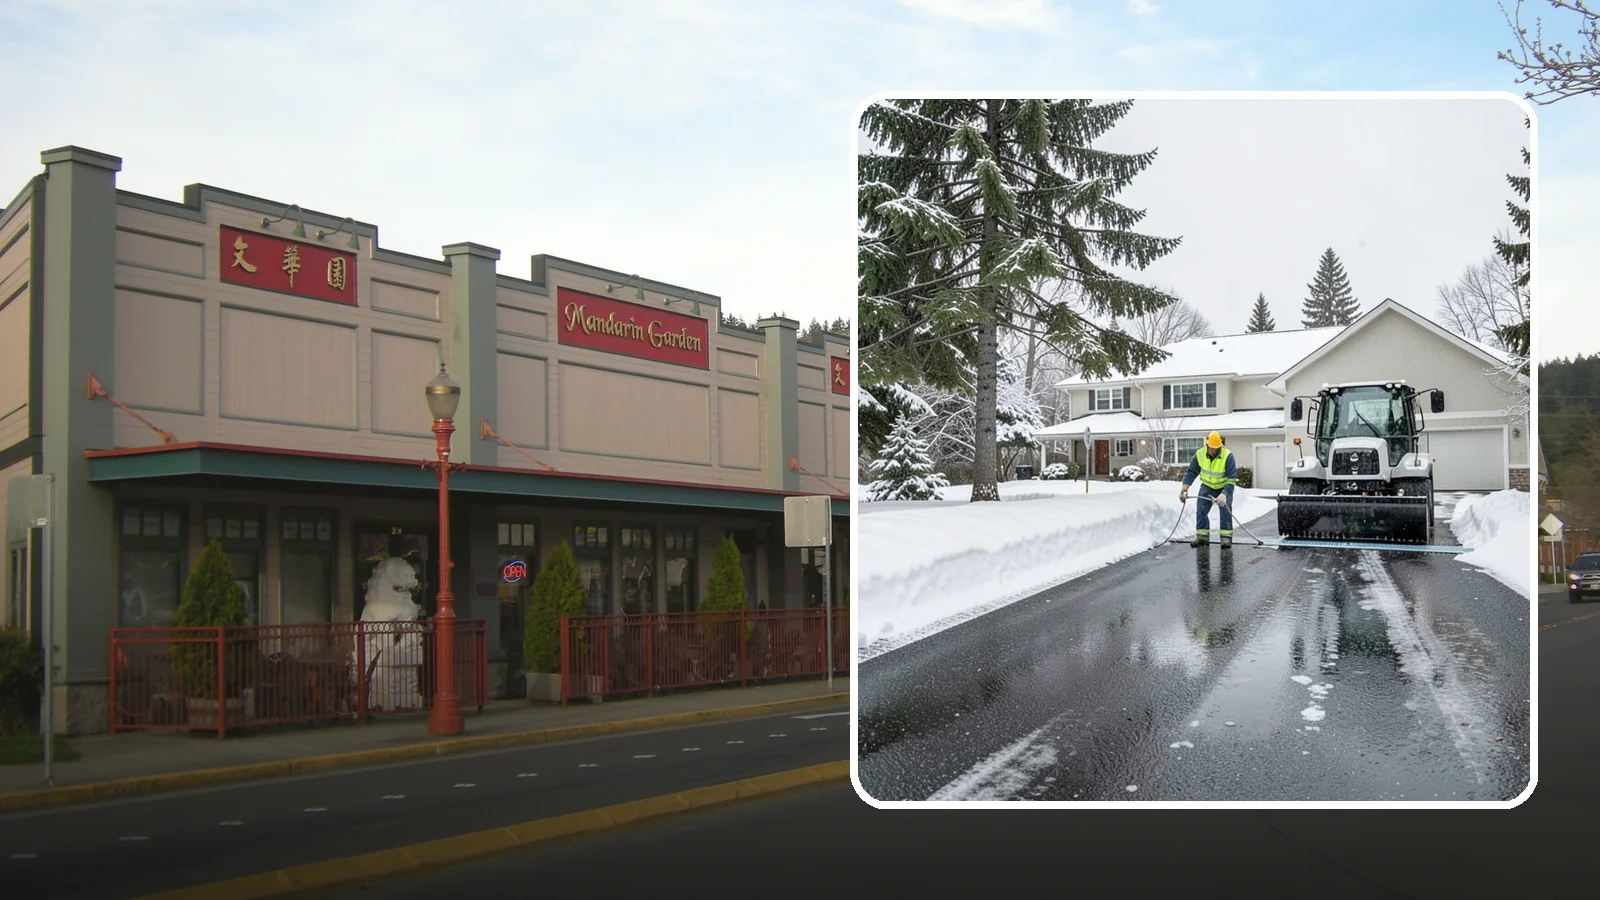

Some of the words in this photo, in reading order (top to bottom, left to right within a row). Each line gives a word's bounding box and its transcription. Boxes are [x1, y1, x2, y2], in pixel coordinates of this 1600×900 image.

[230, 235, 346, 291] 文華園
[564, 302, 644, 342] Mandarin
[647, 320, 701, 352] Garden
[834, 363, 846, 386] 文
[503, 565, 527, 578] OPEN
